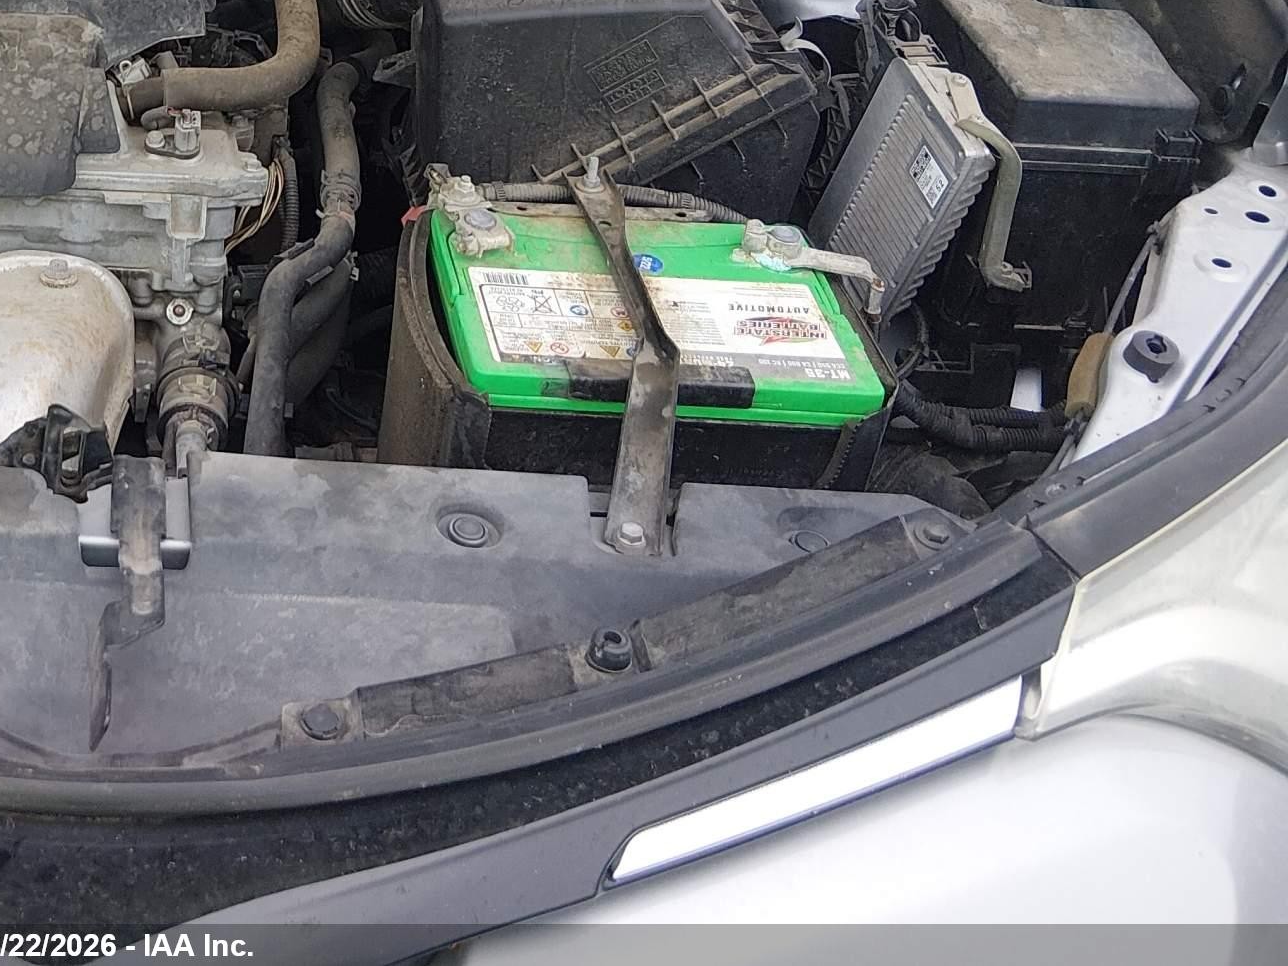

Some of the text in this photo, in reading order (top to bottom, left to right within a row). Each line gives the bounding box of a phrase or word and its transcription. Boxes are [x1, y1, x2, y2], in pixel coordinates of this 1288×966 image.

[728, 303, 810, 314] AUTOMOTIVE
[737, 320, 820, 330] BATTERIES
[735, 327, 827, 339] INTERSTATE
[805, 367, 851, 379] MT-35
